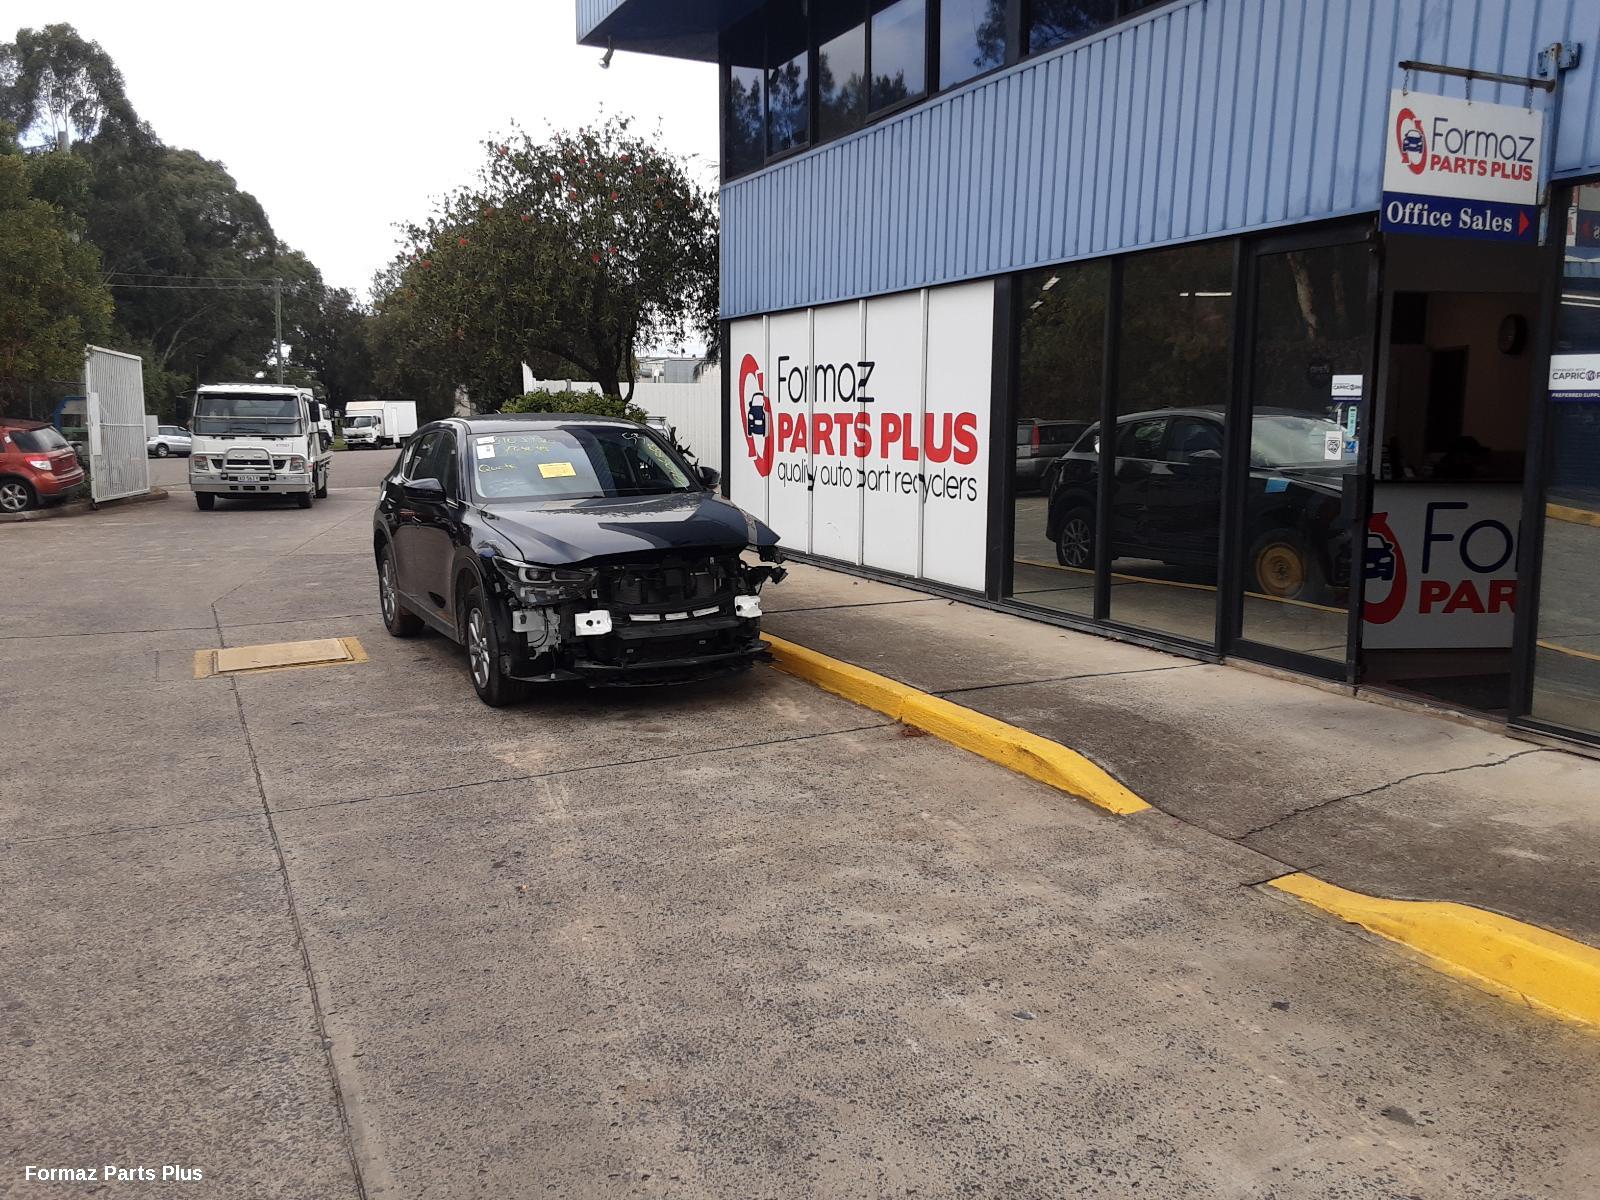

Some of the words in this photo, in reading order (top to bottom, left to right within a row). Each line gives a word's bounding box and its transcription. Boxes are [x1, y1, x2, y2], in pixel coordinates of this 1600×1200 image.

[1431, 116, 1535, 163] Formaz
[1430, 153, 1488, 177] PARTS
[1490, 162, 1533, 182] PLUS
[1386, 201, 1452, 228] Office
[1458, 207, 1513, 233] Sales
[777, 355, 875, 403] Formaz
[777, 411, 872, 458] PARTS
[880, 411, 978, 465] PLUS
[820, 460, 853, 487] auto
[894, 467, 977, 503] recyclers
[1421, 501, 1521, 574] Fo
